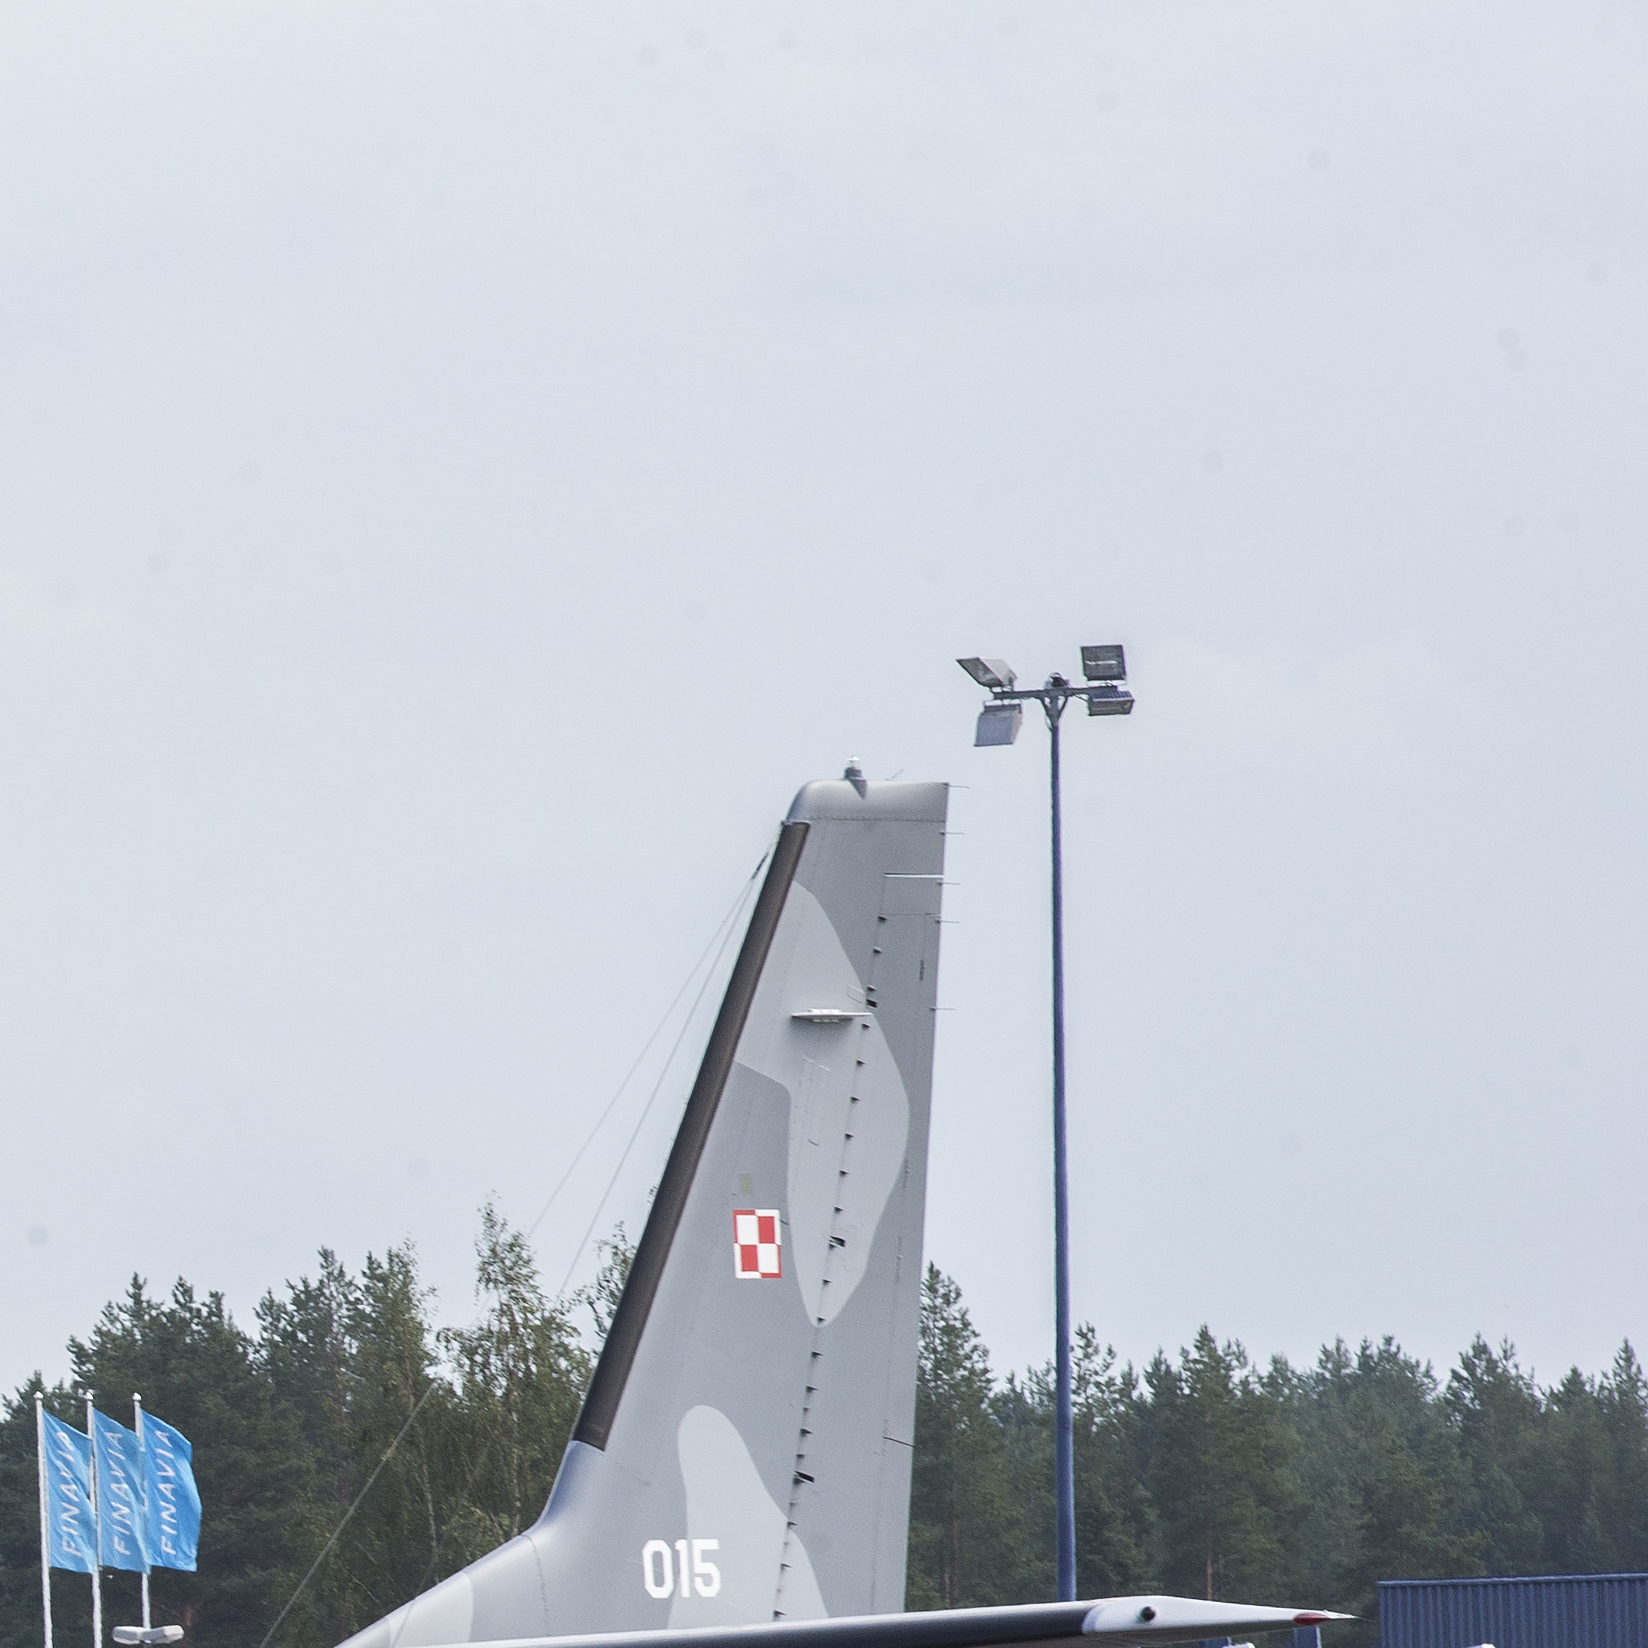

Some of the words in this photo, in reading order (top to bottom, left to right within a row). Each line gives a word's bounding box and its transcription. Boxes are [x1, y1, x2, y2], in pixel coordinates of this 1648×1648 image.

[104, 1431, 132, 1556] FINAVIA
[154, 1429, 178, 1556] FINAVIA
[641, 1538, 722, 1599] 015
